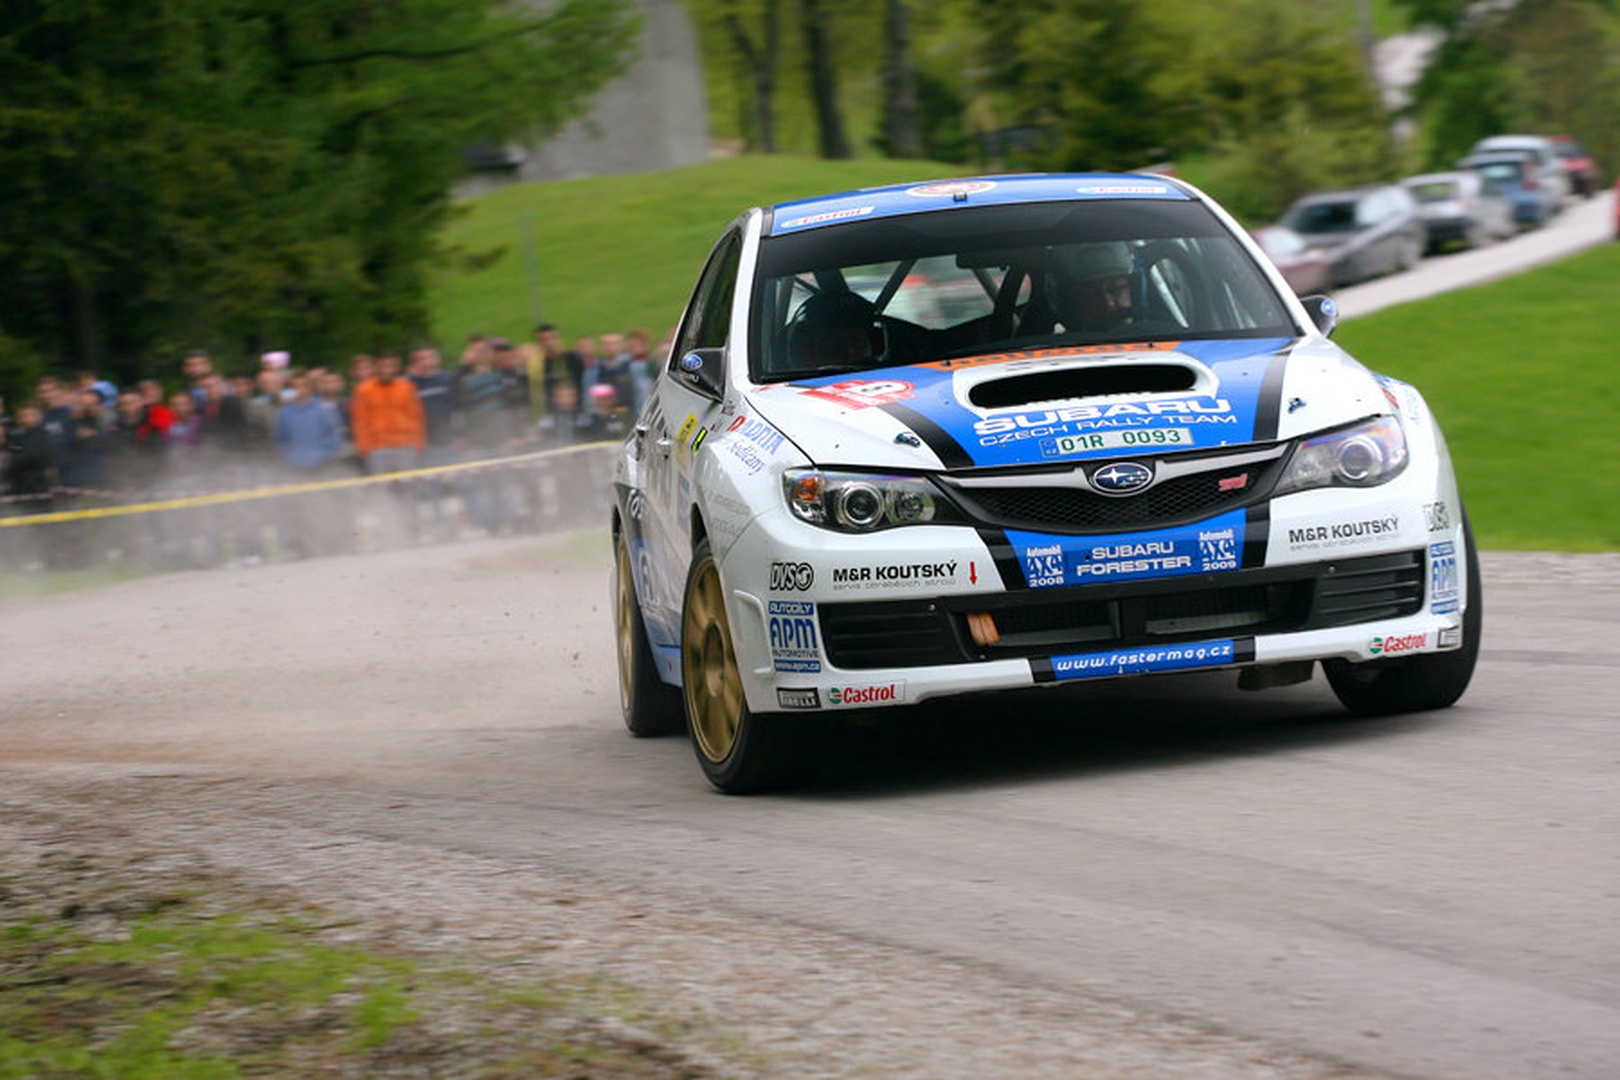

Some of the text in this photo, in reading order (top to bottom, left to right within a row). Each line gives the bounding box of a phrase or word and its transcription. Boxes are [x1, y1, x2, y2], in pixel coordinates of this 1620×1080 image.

[972, 399, 1232, 436] SUBARU
[979, 413, 1238, 447] CZECH RALLY TEAM
[1060, 429, 1182, 452] 01R 0093
[1288, 526, 1329, 544] M&R
[1091, 541, 1175, 560] SUBARU
[832, 558, 958, 583] M&R KOUTSKÝ
[1076, 555, 1192, 577] FORESTER
[1201, 560, 1237, 572] 2009
[1029, 575, 1065, 588] 2008
[770, 616, 818, 649] APM
[1384, 631, 1427, 653] Castrol
[842, 683, 896, 704] Castrol
